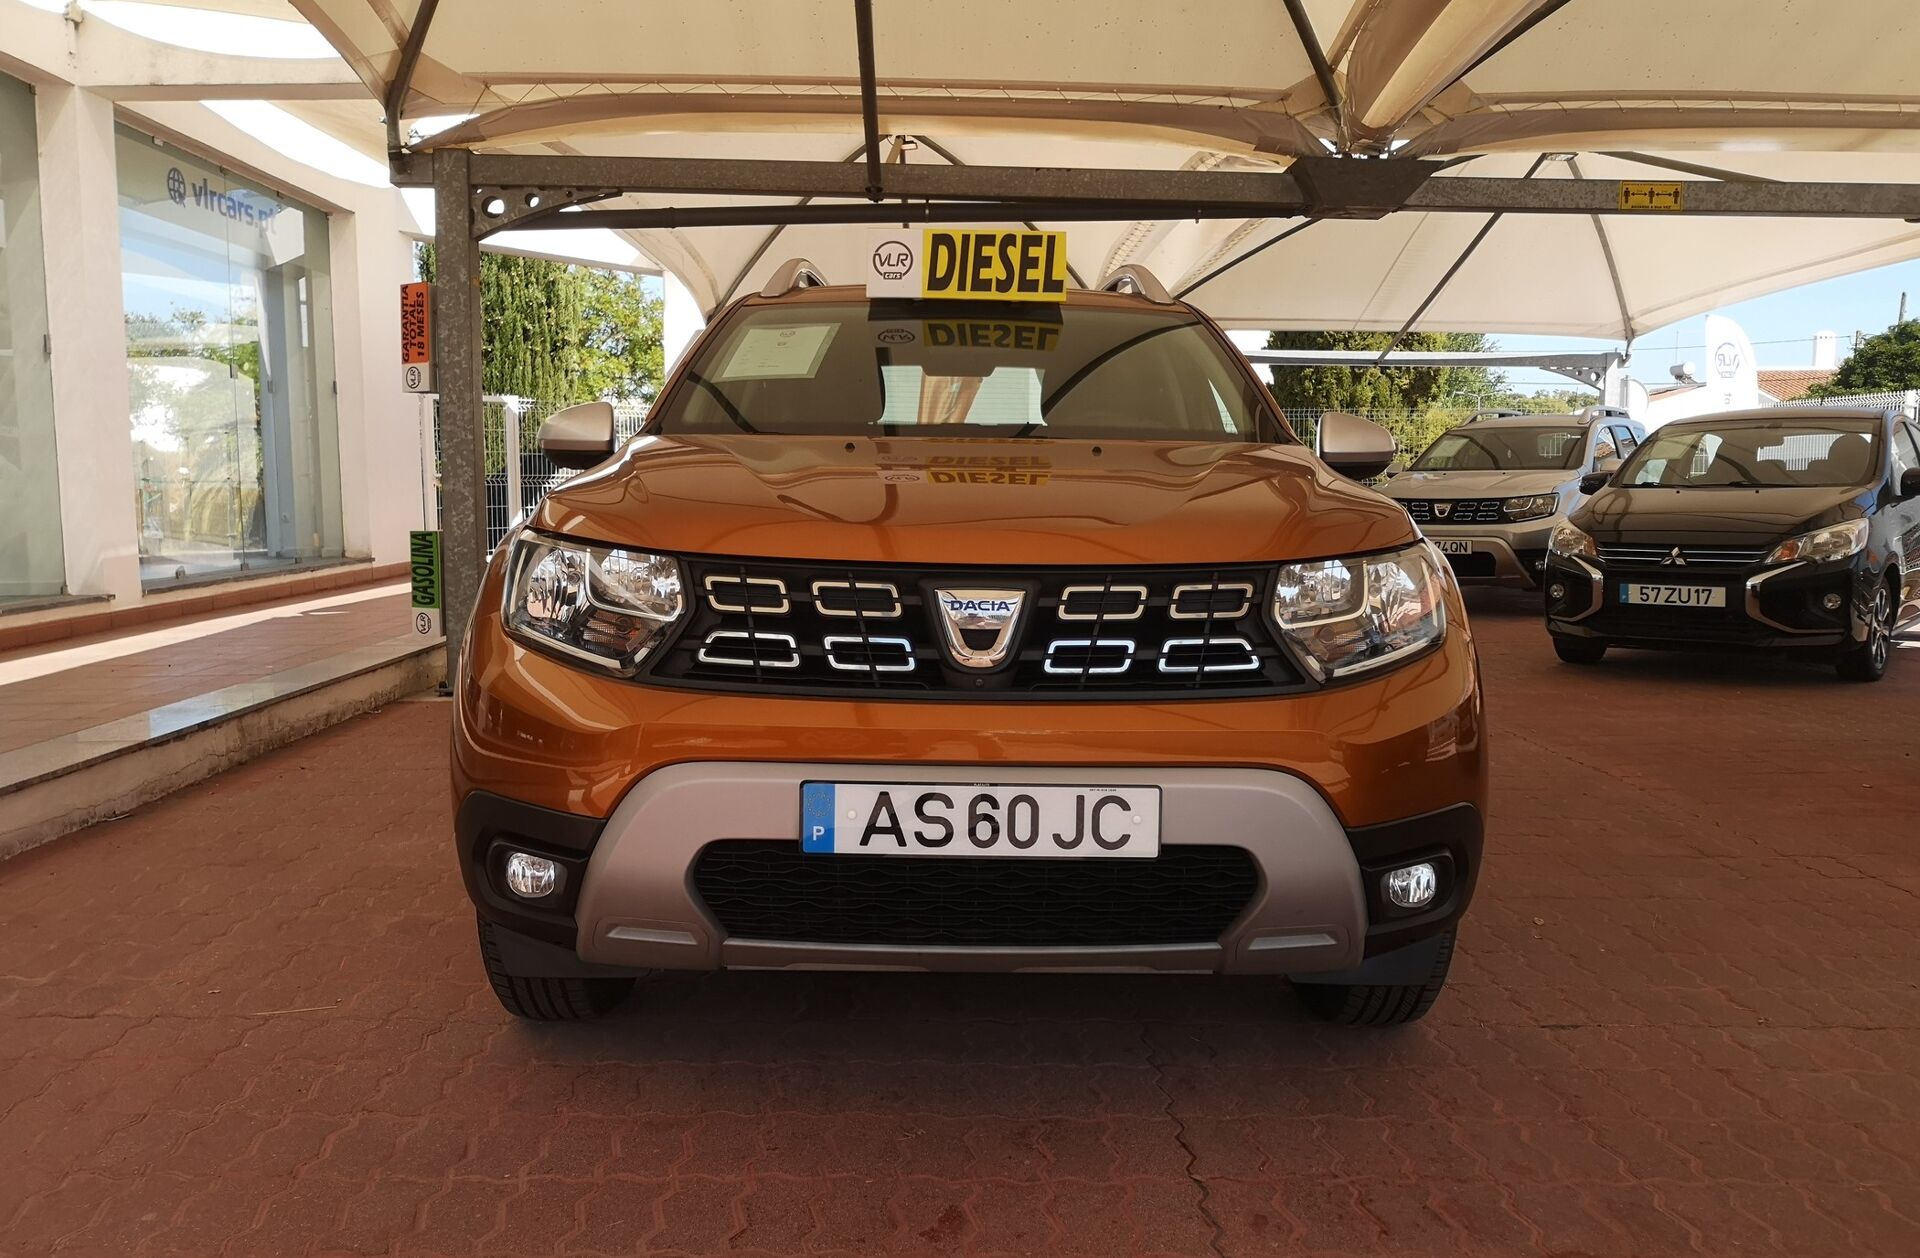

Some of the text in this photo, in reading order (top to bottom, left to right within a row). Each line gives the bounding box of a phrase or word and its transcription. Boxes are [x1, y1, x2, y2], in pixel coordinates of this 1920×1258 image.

[191, 178, 276, 238] vlrcars.pt
[873, 252, 908, 267] VLR
[927, 233, 1064, 293] DIESEL
[402, 285, 410, 363] GARANTIA
[409, 300, 417, 348] TOTAL
[416, 291, 425, 357] 18 MESES
[411, 531, 435, 606] GASOLINA
[950, 600, 1011, 612] DACIA
[812, 826, 825, 841] P
